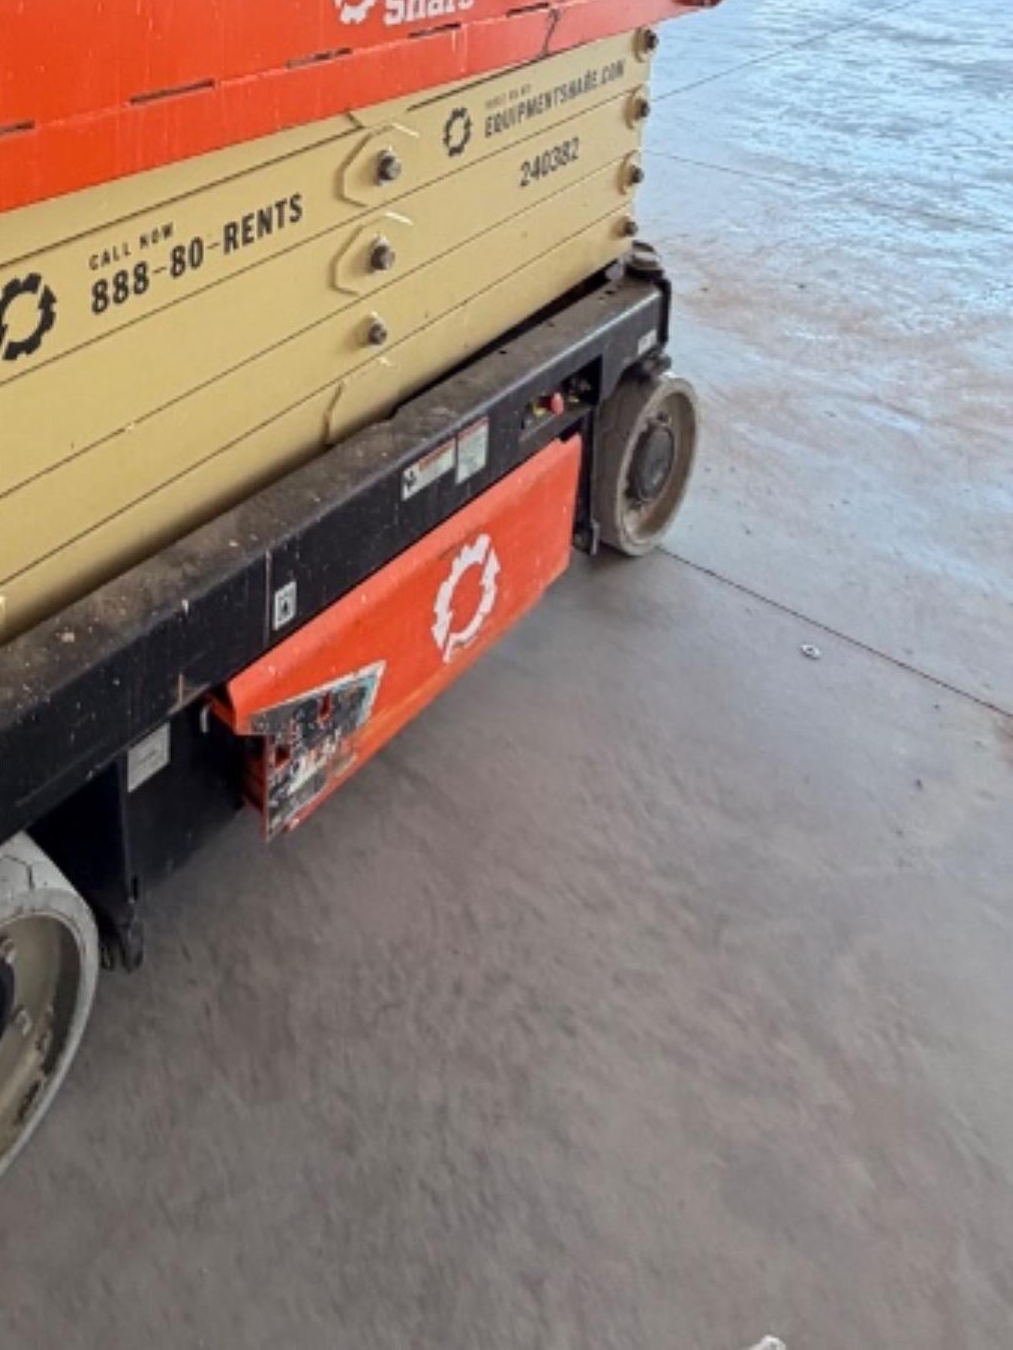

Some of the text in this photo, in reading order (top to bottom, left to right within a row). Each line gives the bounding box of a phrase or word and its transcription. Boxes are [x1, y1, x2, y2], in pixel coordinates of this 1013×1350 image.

[485, 59, 626, 138] EQUIPMENTSHARE.COM
[520, 137, 580, 187] 240382
[89, 242, 131, 271] CALL
[91, 193, 304, 315] 888-80-RENTS
